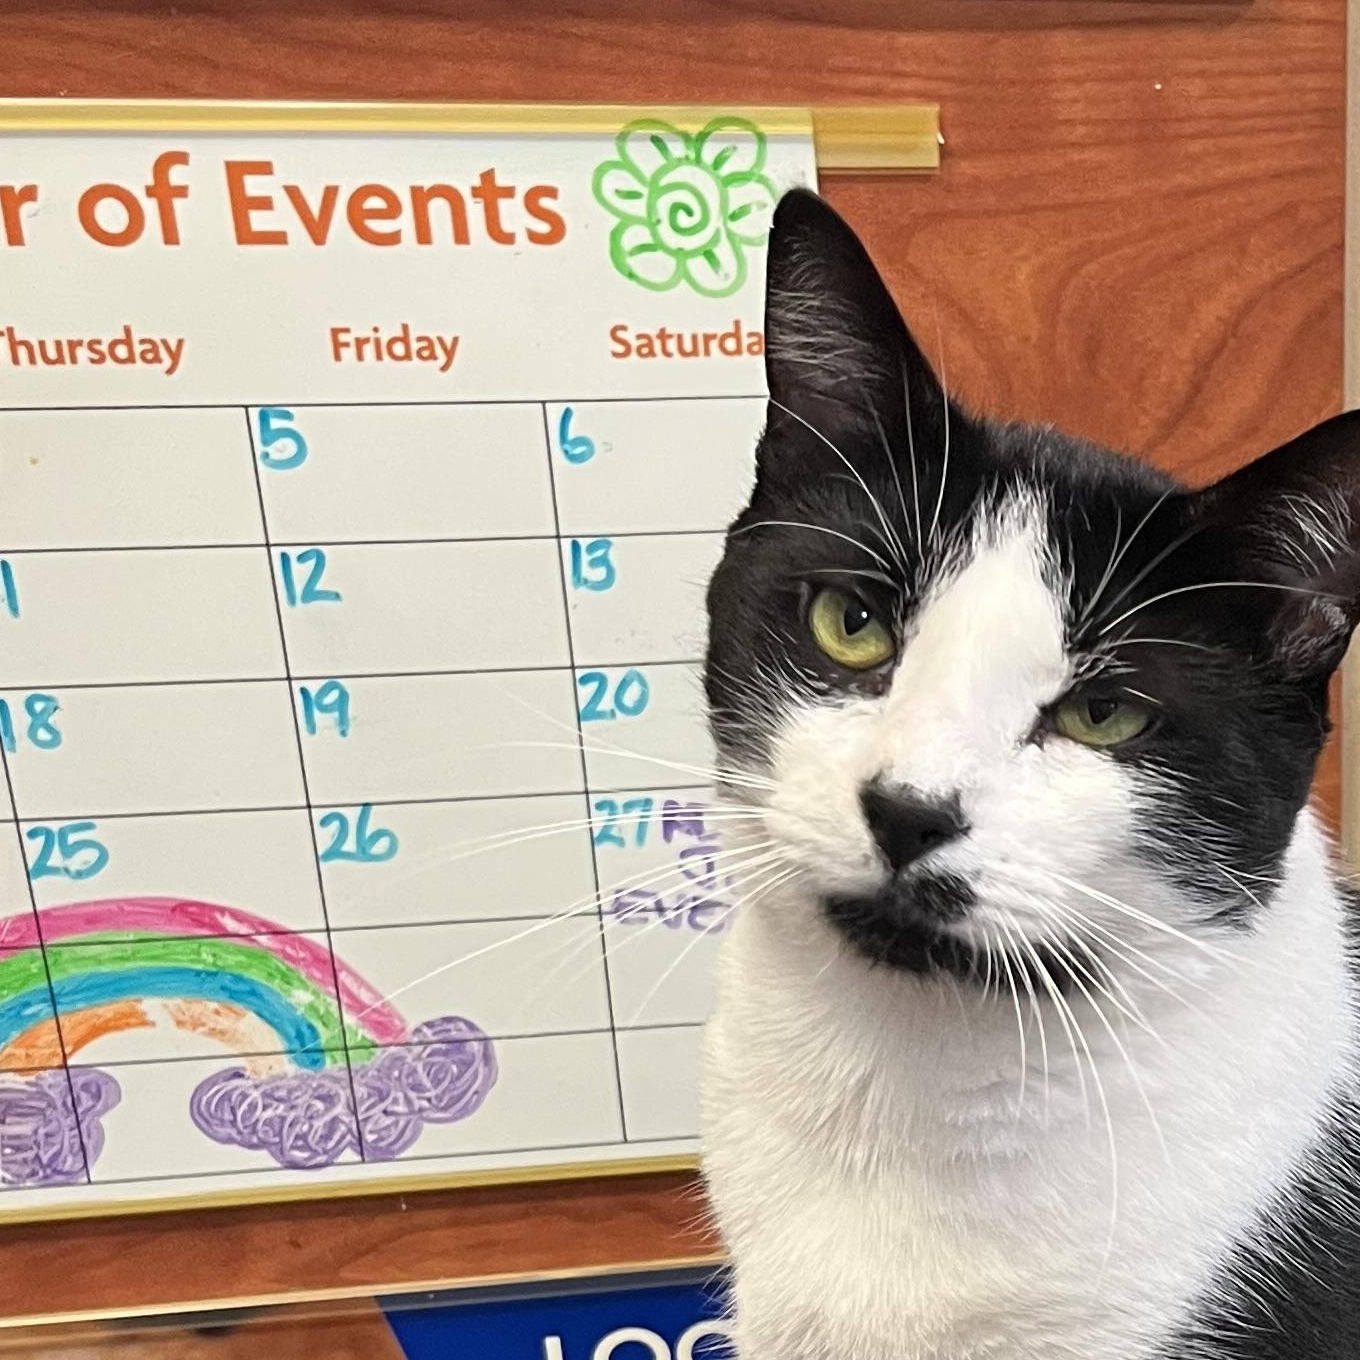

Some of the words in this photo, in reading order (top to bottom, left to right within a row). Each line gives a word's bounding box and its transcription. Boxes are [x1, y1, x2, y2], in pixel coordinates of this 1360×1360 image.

[78, 150, 190, 248] of
[224, 160, 568, 247] Events
[0, 324, 184, 376] hursday
[330, 323, 460, 373] Friday
[609, 319, 765, 359] Saturda
[258, 406, 309, 471] 5
[559, 407, 597, 465] 6
[280, 548, 343, 608] 12
[570, 538, 617, 593] 13
[0, 693, 62, 753] 18
[301, 680, 352, 738] 19
[577, 668, 652, 723] 20
[26, 821, 110, 880] 25
[319, 803, 399, 863] 26
[594, 797, 654, 847] 27
